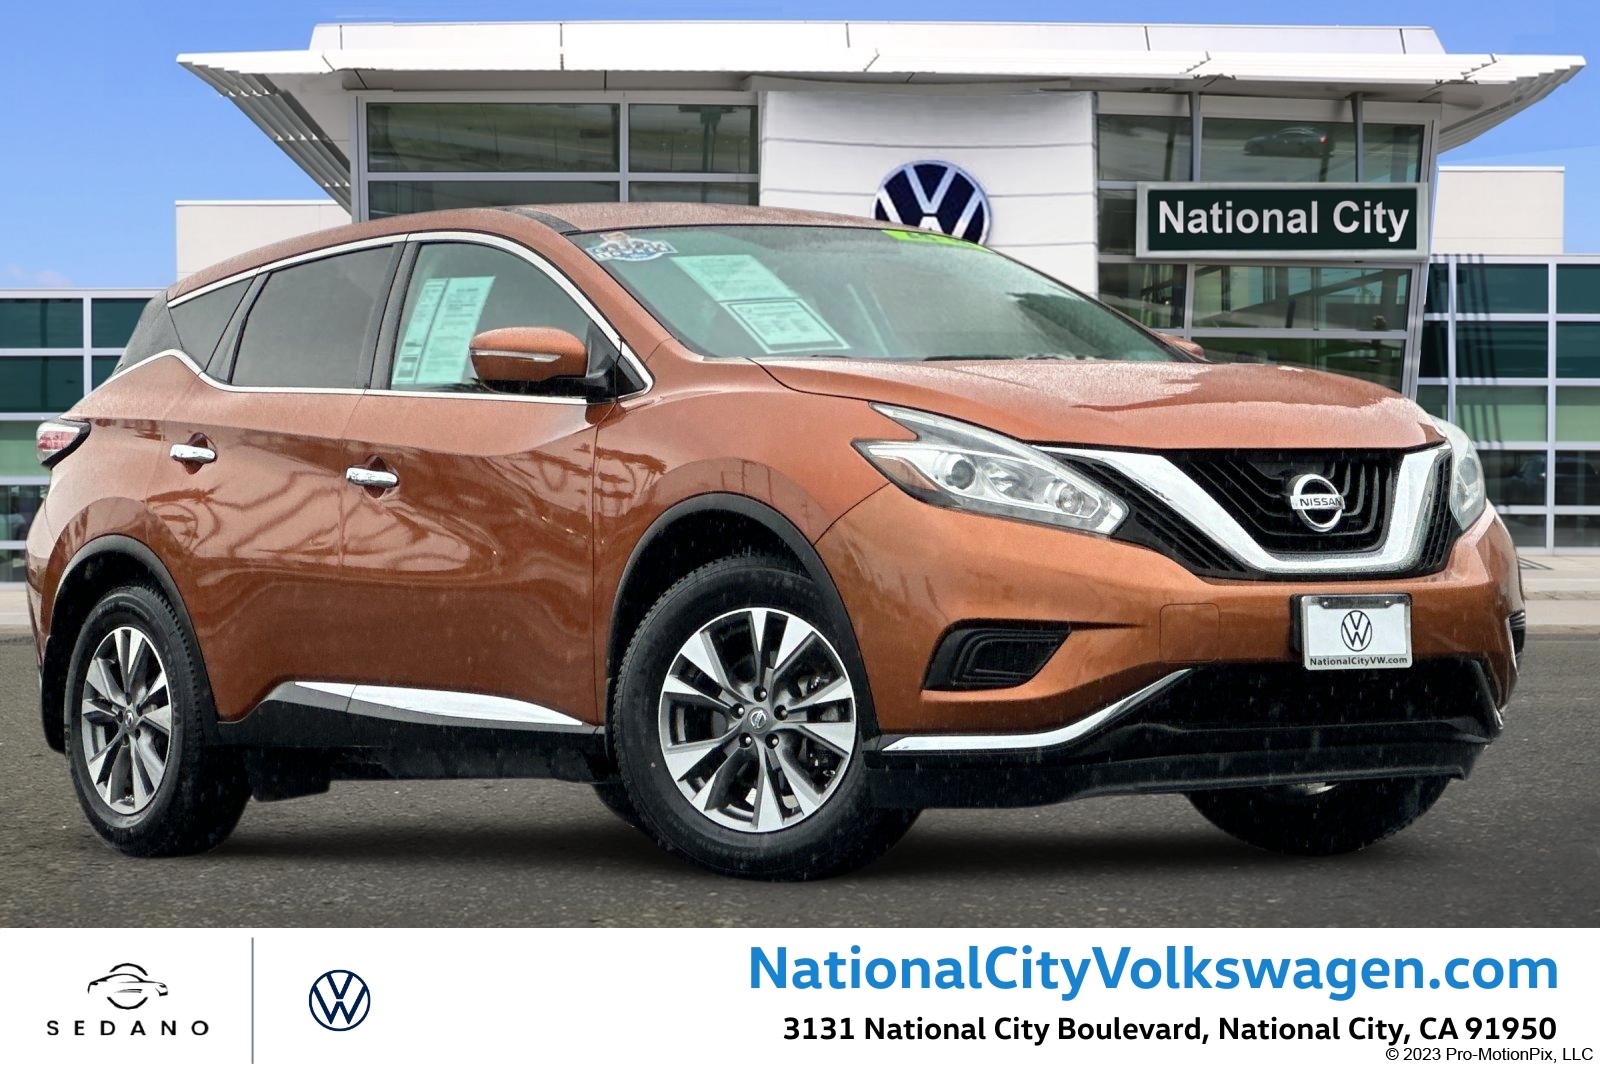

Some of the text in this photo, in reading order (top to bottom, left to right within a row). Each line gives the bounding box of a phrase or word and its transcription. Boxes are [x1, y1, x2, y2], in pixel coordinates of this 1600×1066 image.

[1159, 200, 1410, 243] National City
[1299, 497, 1341, 507] NISSAN
[1341, 610, 1372, 652] VW
[1309, 656, 1408, 666] NationalCityVW.com
